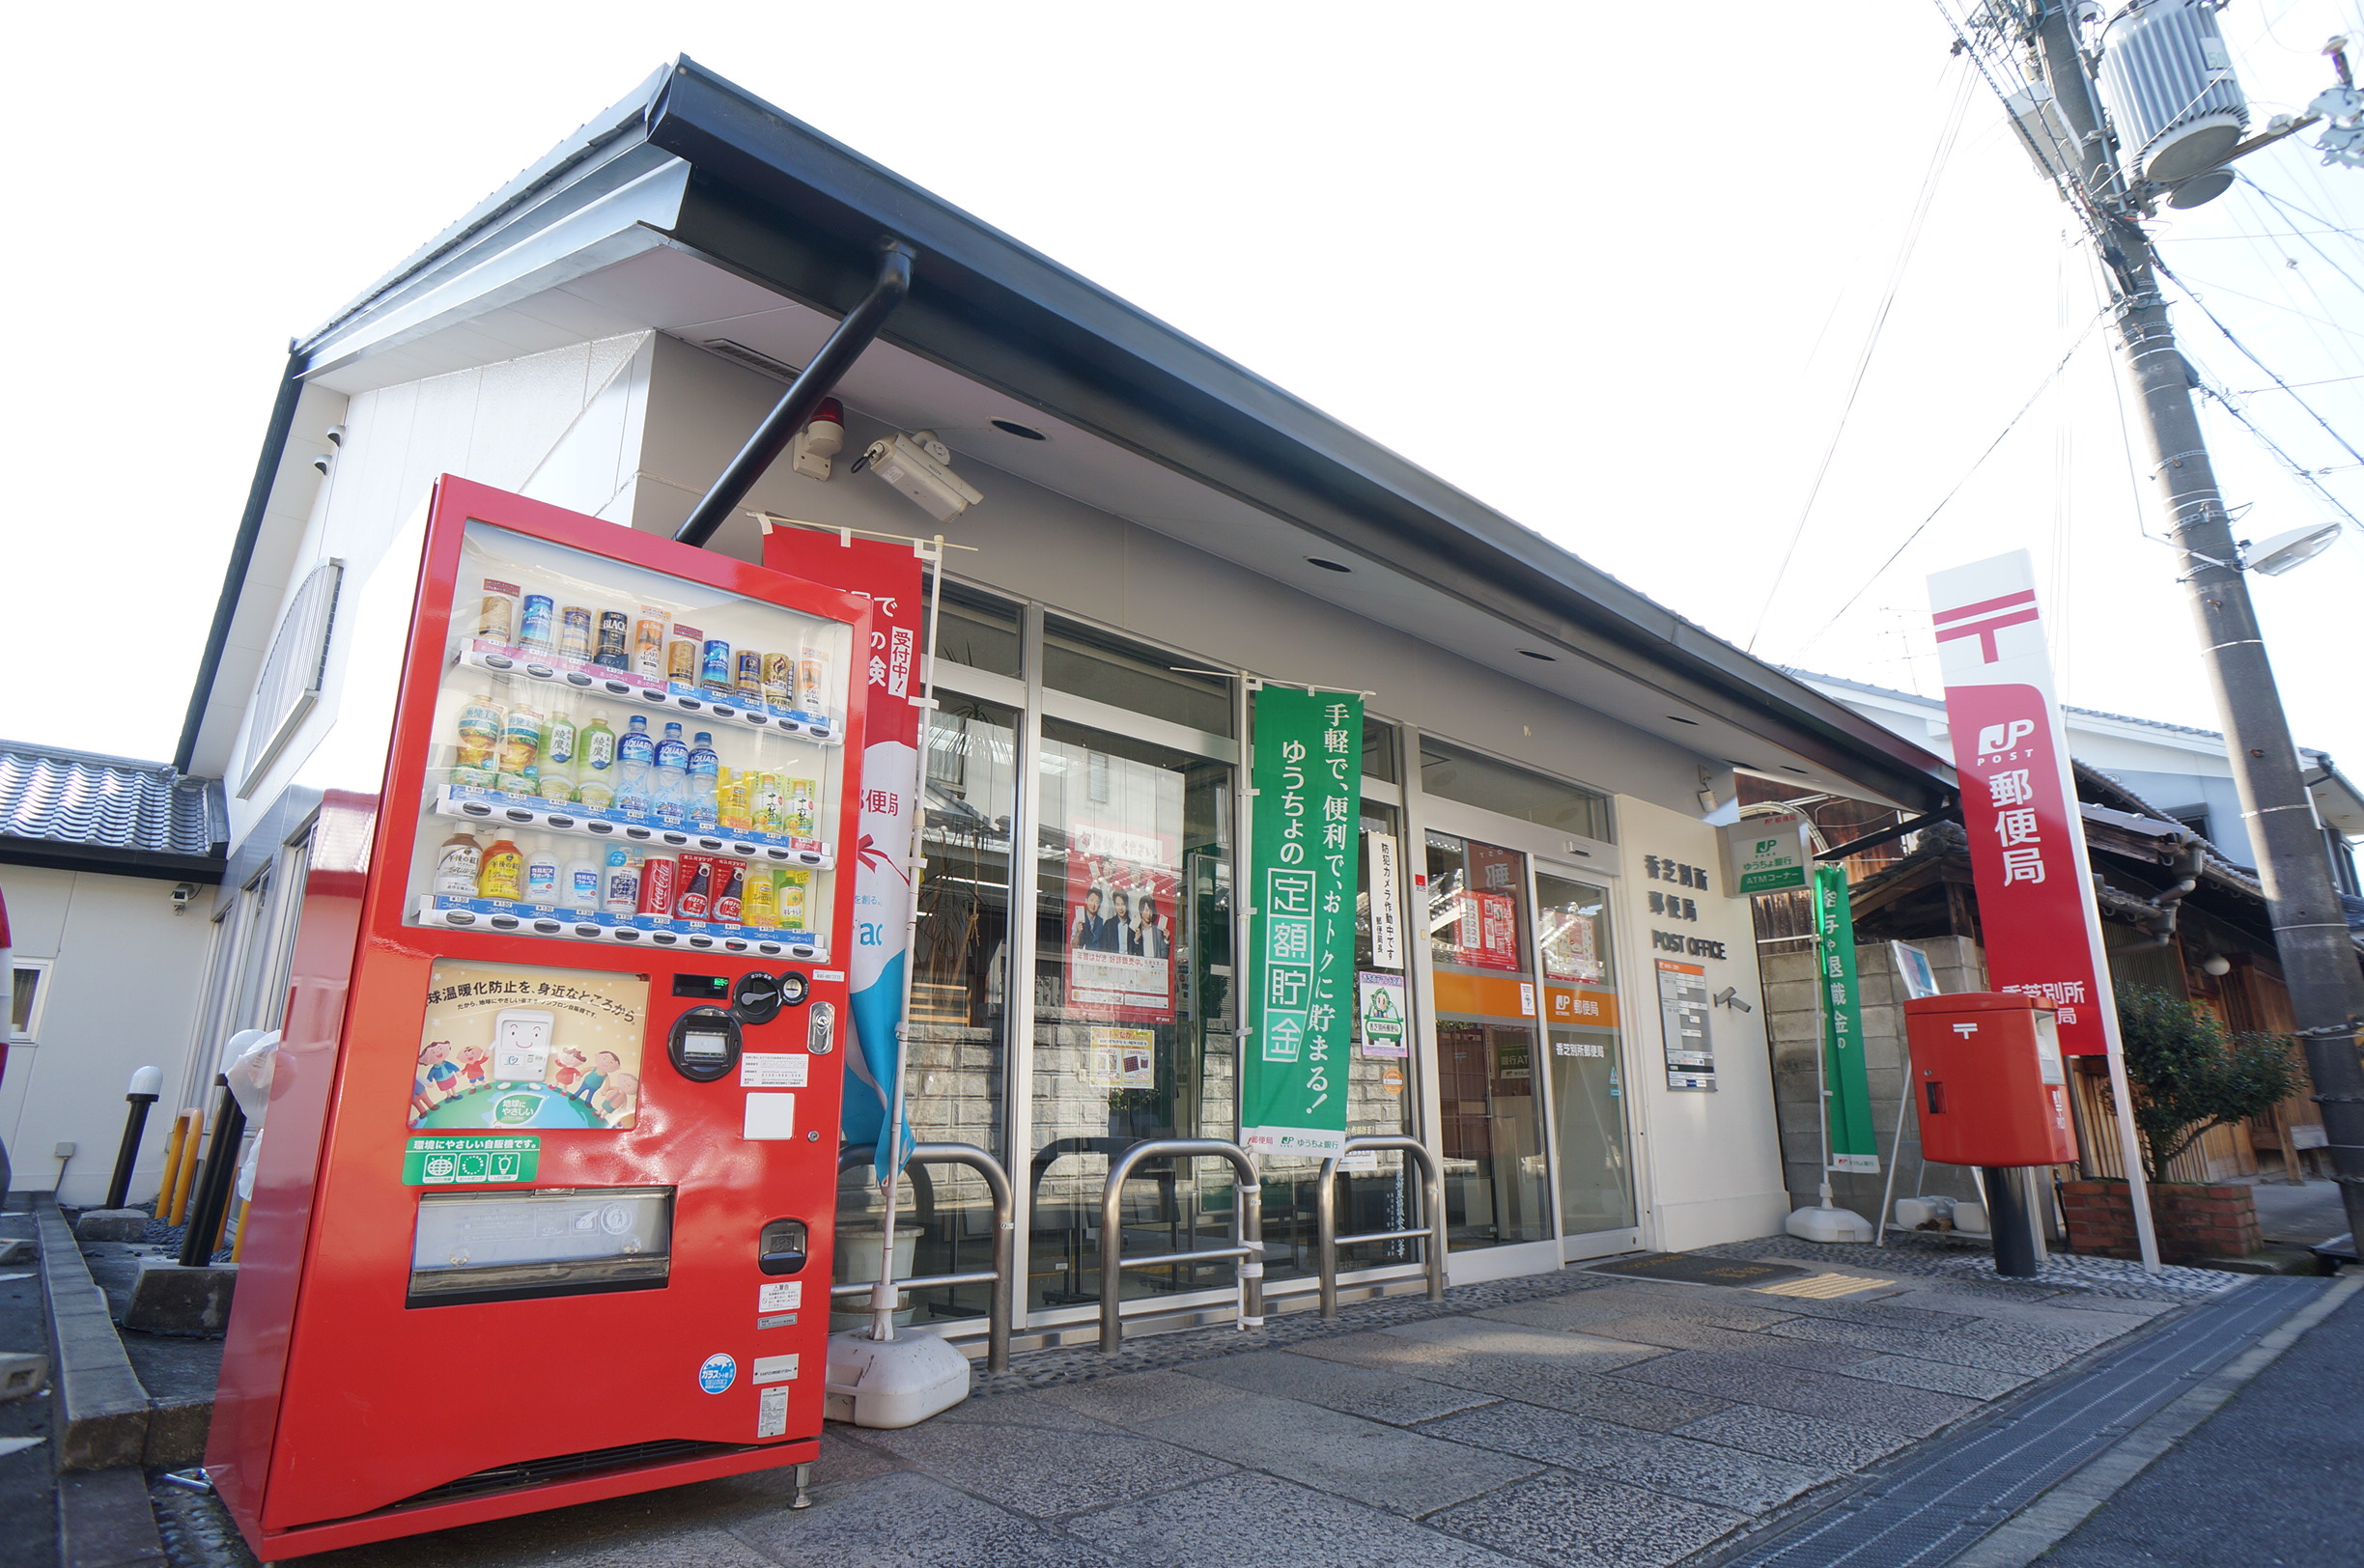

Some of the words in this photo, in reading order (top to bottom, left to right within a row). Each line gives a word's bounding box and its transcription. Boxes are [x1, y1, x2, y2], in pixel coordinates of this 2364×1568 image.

[1978, 718, 2035, 756] JP
[1977, 748, 2034, 767] POST
[860, 789, 898, 817] 便局
[1988, 769, 2046, 887] 郵便局
[1756, 839, 1777, 854] JP
[1644, 854, 1708, 891] 香芝別所
[1743, 856, 1792, 871] ゆうちょ銀行
[1746, 872, 1799, 885] ATMコーナー
[1381, 842, 1394, 961] 防犯カメラ作動中です
[1647, 890, 1698, 922] 郵便局
[1375, 916, 1384, 954] 郵便局長
[1651, 929, 1685, 953] POST
[1686, 937, 1728, 961] OFFICE
[426, 980, 635, 1025] 球温暖化防止を、身近なところから。
[1573, 999, 1599, 1017] 郵便局
[2054, 1007, 2077, 1025] 局
[1555, 1042, 1605, 1058] 香芝別所郵便局
[501, 1107, 534, 1116] やさしい
[502, 1099, 526, 1108] 地球に
[413, 1139, 536, 1150] 環境にやさしい自販機です。
[1297, 1139, 1339, 1150] ゆうちょ銀行
